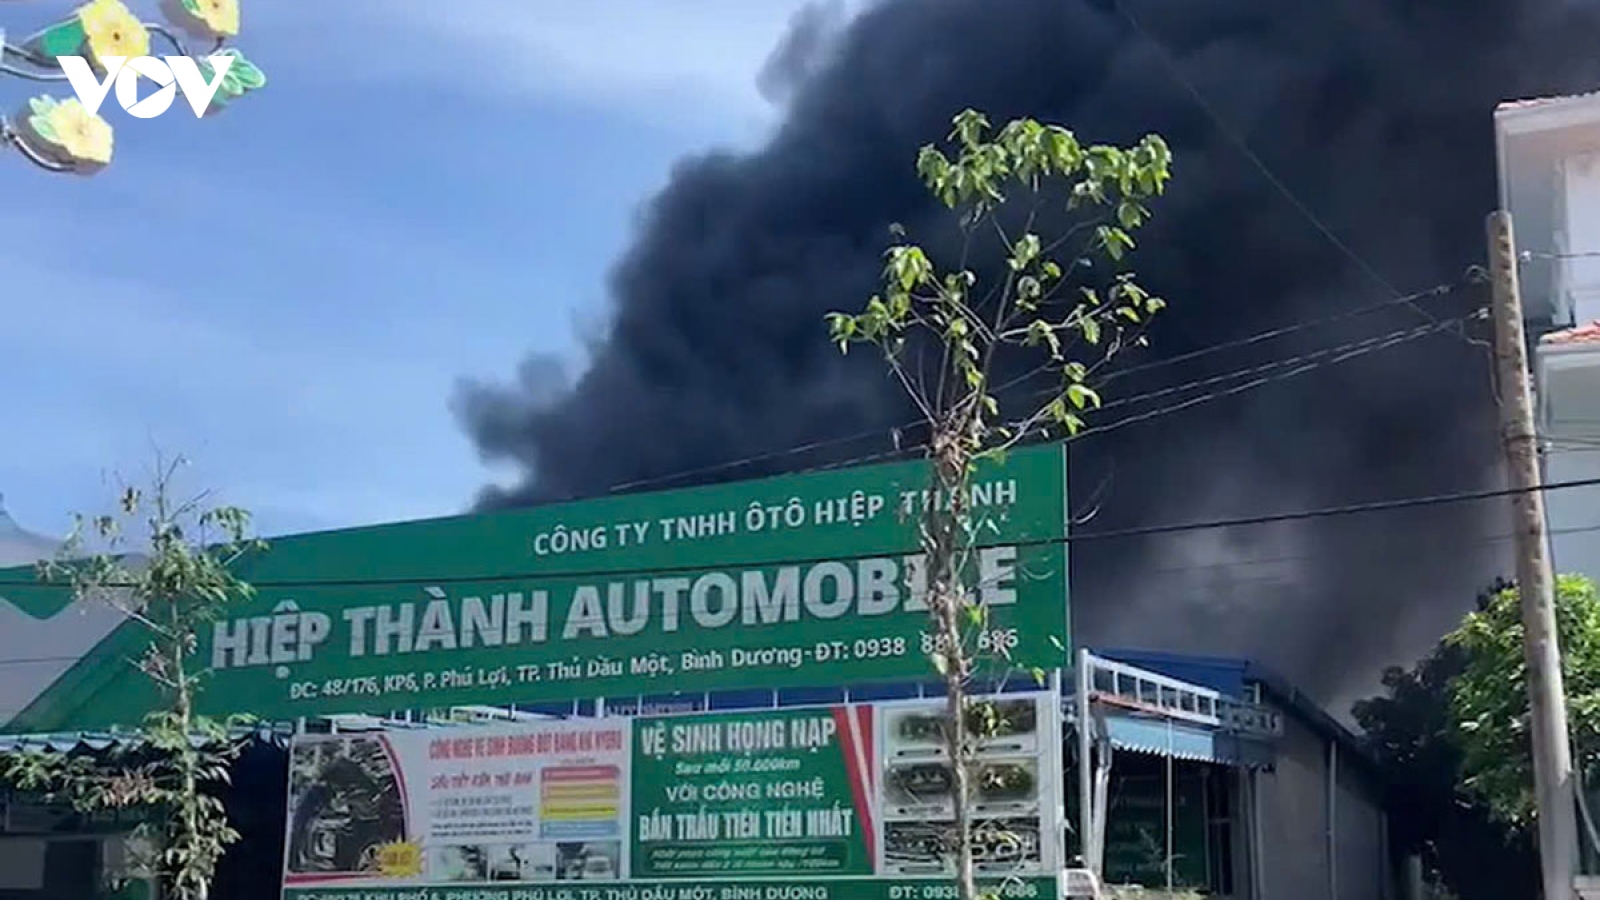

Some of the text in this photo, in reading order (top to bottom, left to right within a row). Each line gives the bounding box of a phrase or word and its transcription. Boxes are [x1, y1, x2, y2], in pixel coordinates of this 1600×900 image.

[534, 523, 607, 555] CÔNG
[615, 521, 649, 546] TY
[660, 511, 736, 541] TNHH
[746, 501, 806, 532] ÔTÔ
[815, 490, 885, 527] HIỆP
[212, 546, 1018, 679] HIỆP THÀNH AUTOMOBIE
[290, 682, 317, 700] ĐC:
[322, 676, 380, 696] 48/176,
[384, 672, 420, 693] KP6,
[423, 672, 437, 689] P.
[440, 665, 473, 689] Phú
[478, 665, 513, 690] Lợi,
[517, 664, 542, 683] TP.
[547, 656, 581, 681] Thủ
[587, 655, 624, 677] Dầu
[630, 651, 674, 678] Một,
[682, 649, 724, 671] Bình
[854, 637, 905, 658] 0938
[641, 721, 666, 761] VỆ
[672, 722, 721, 754] SINH
[727, 718, 786, 757] HỌNG
[791, 718, 837, 753] NẠP
[703, 778, 762, 800] CÔNG
